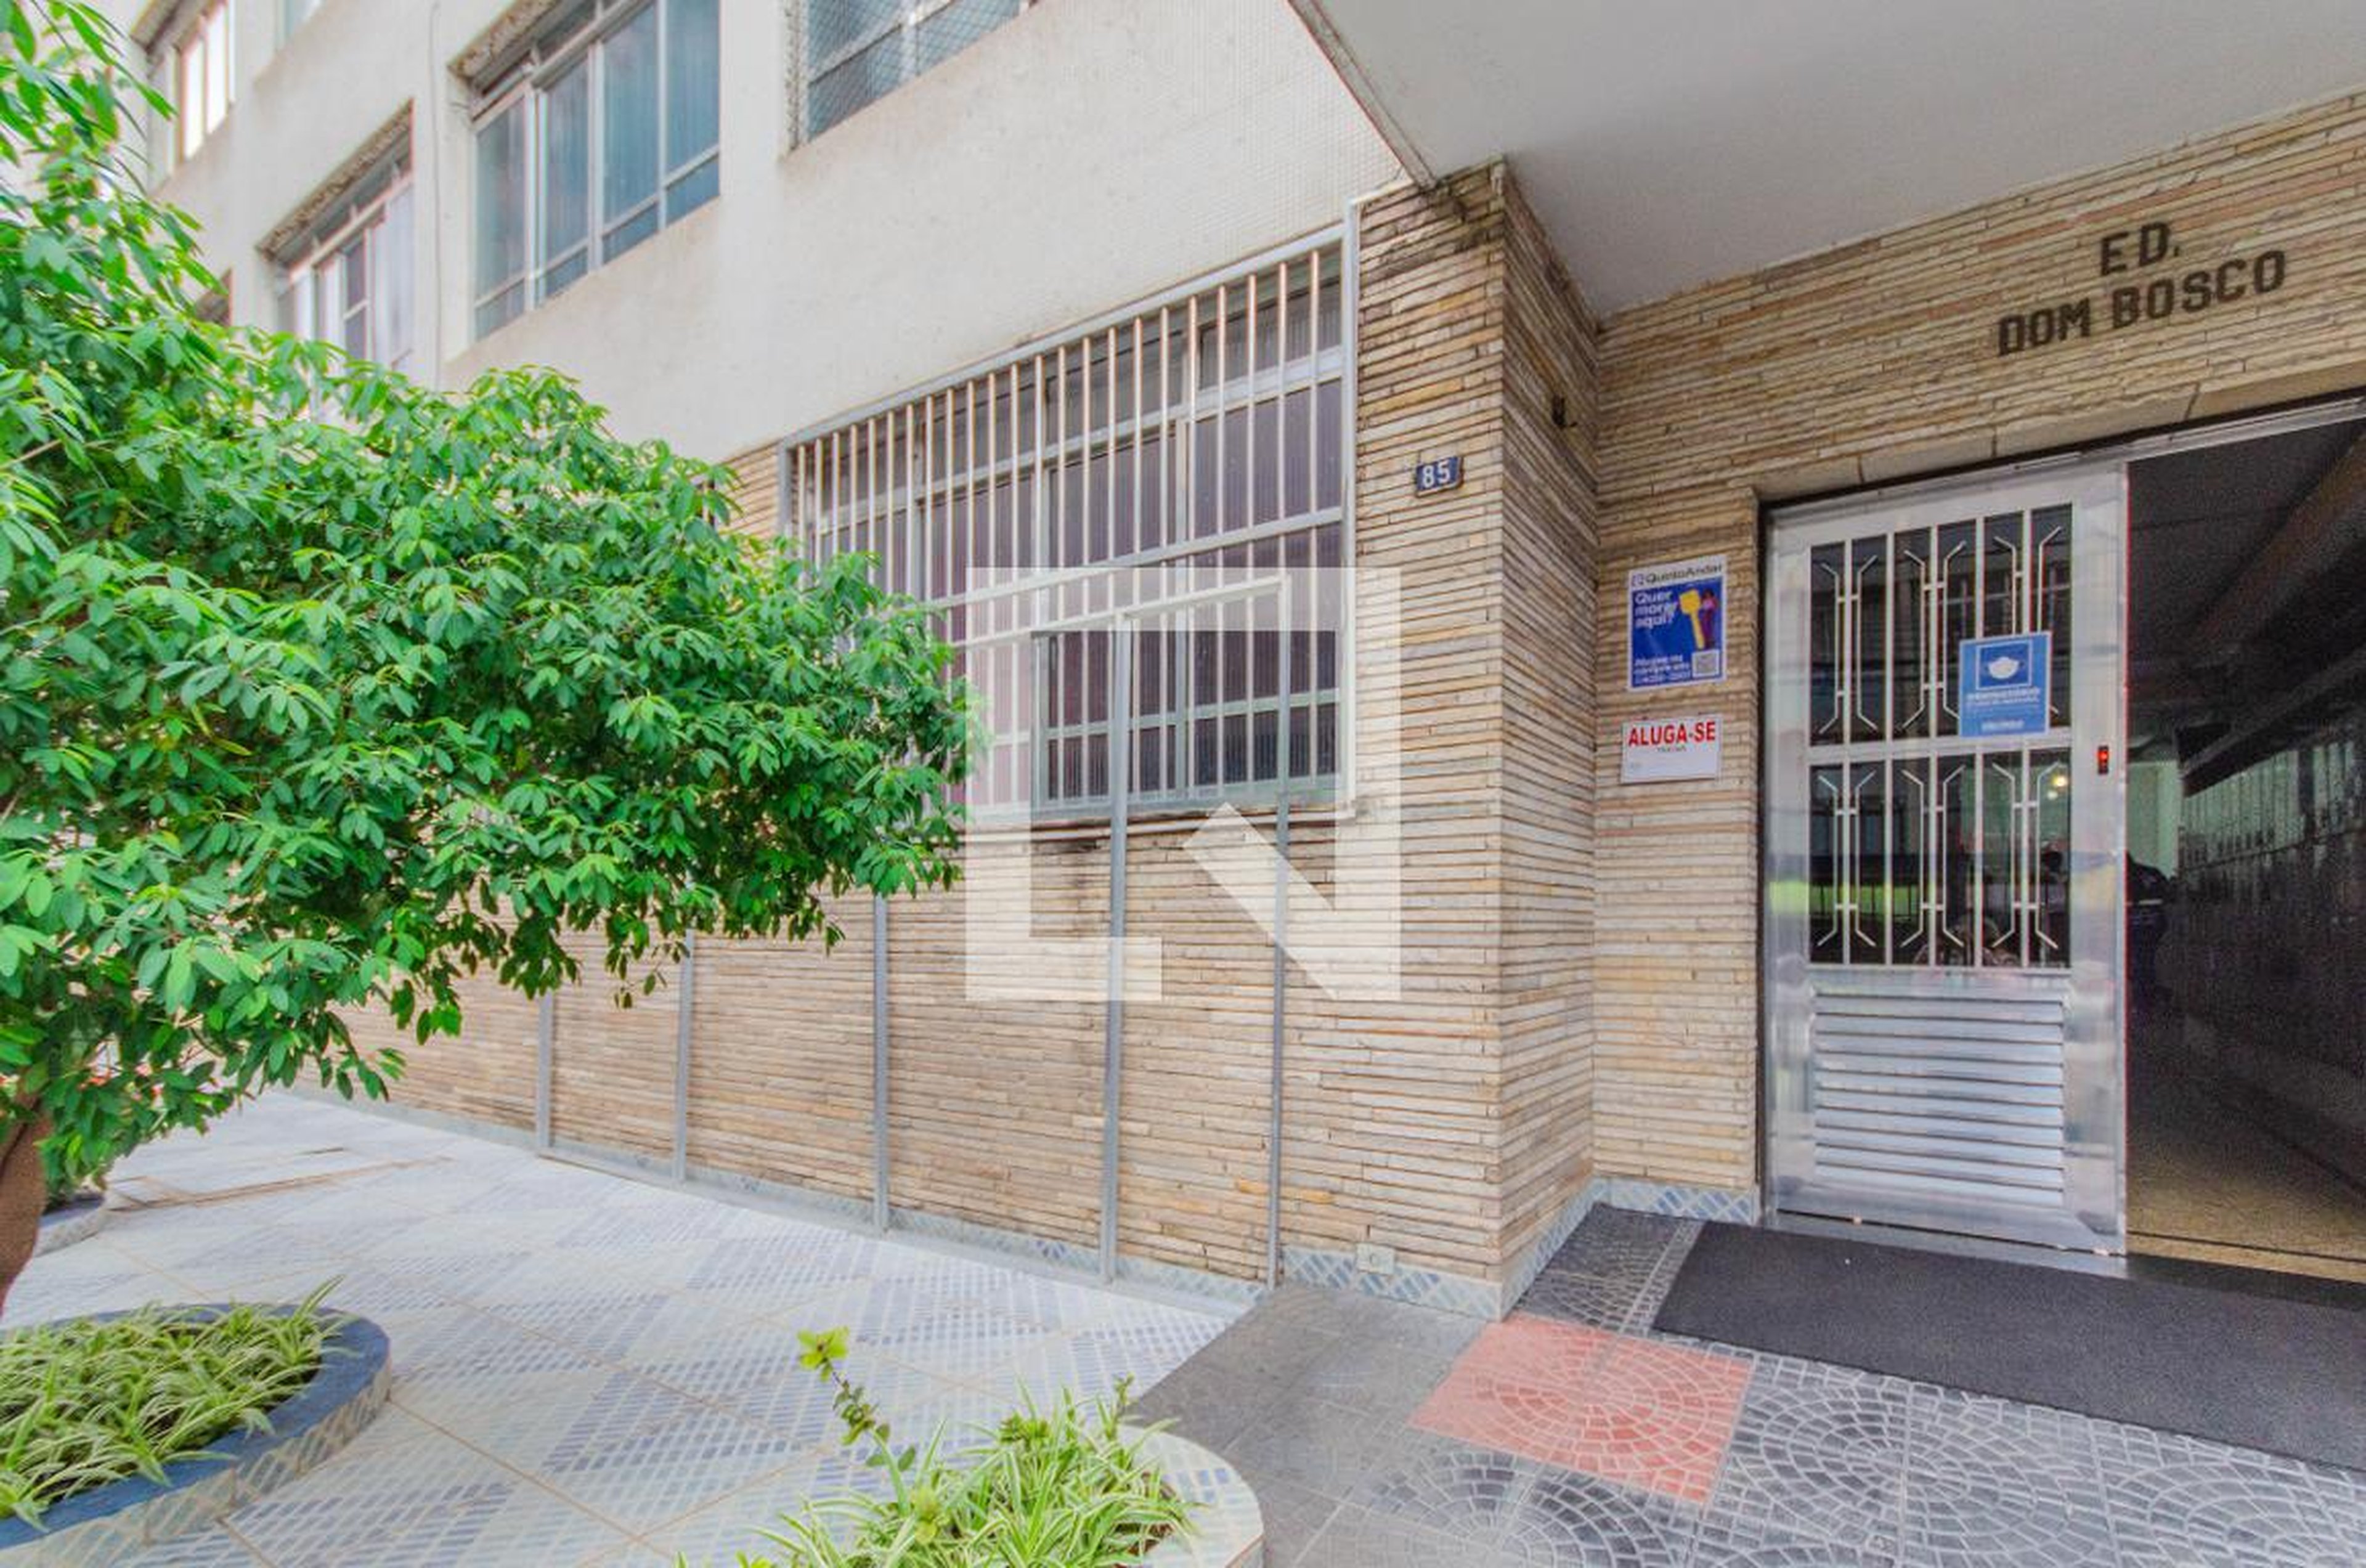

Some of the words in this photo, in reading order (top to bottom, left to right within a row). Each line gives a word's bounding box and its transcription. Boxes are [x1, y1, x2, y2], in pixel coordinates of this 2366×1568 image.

[2100, 221, 2180, 277] ED.
[1998, 297, 2091, 357] DOM
[2112, 250, 2286, 329] BOSCO
[1422, 460, 1450, 489] 85
[1628, 721, 1716, 747] ALUGA-SE
